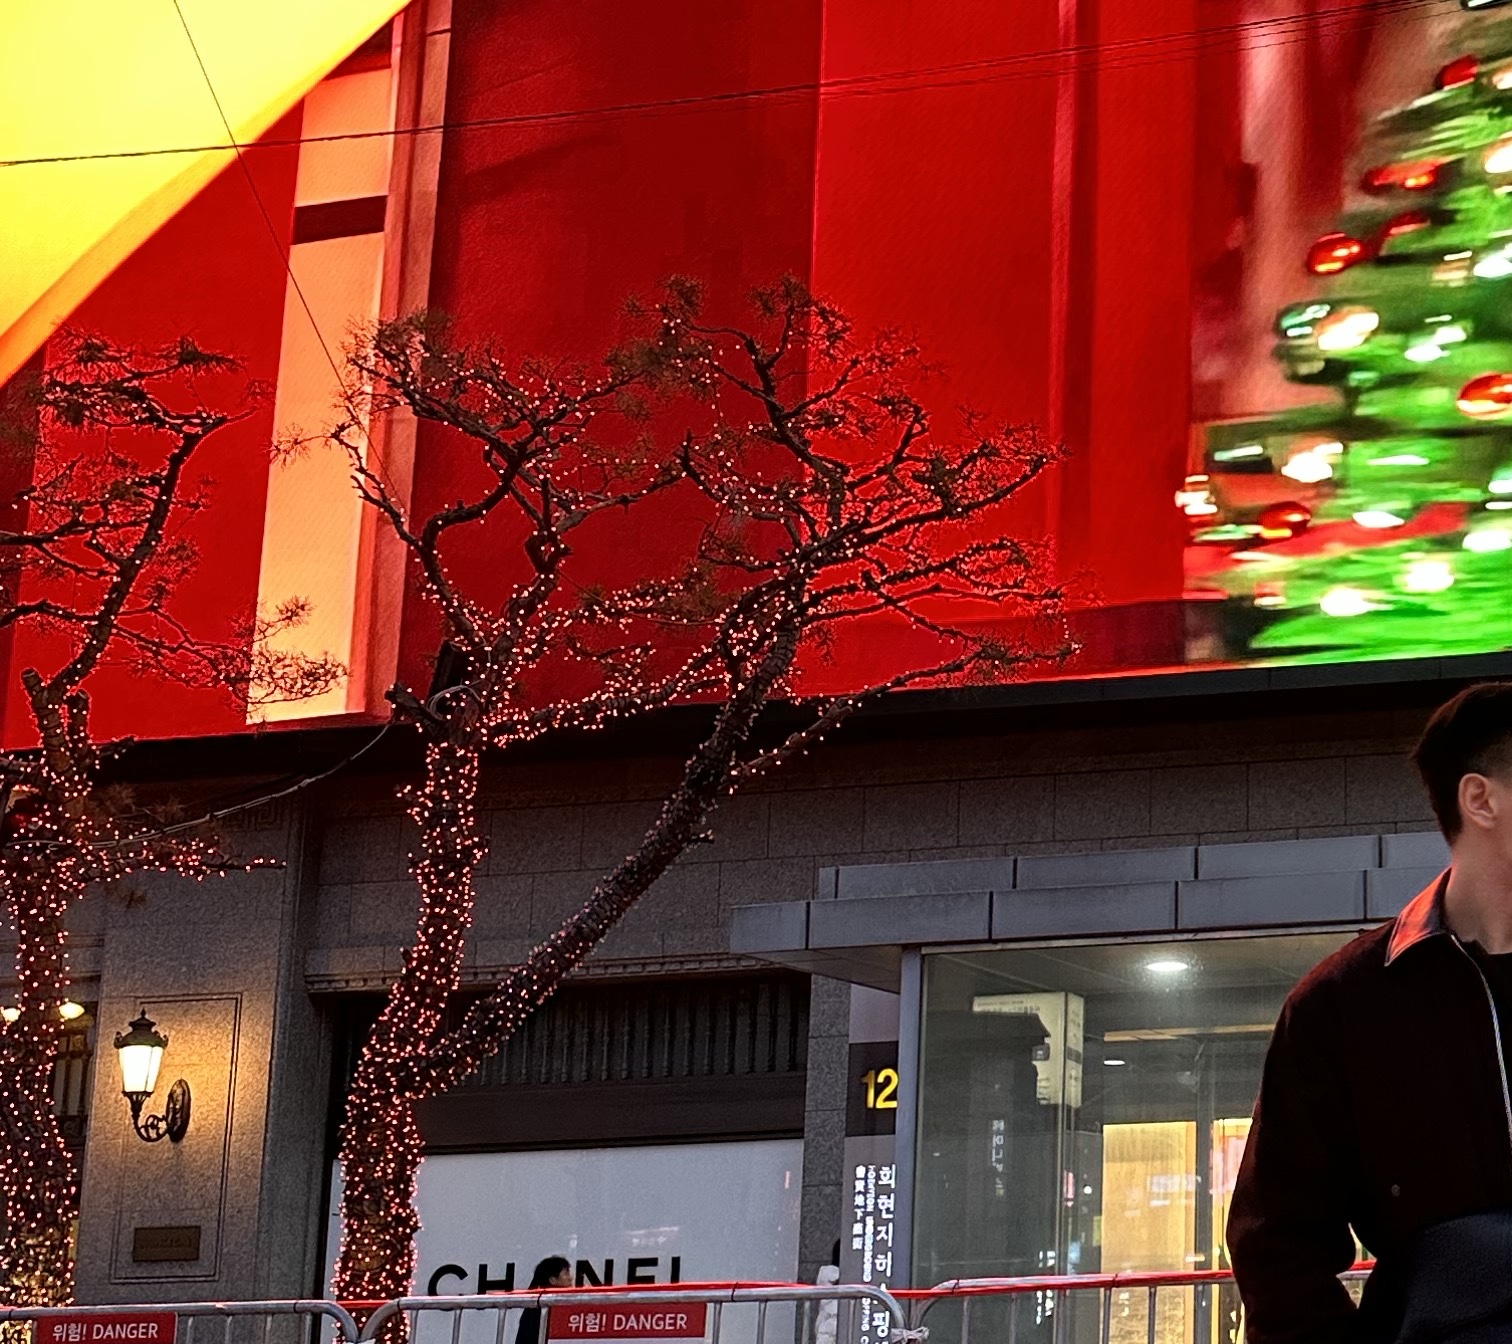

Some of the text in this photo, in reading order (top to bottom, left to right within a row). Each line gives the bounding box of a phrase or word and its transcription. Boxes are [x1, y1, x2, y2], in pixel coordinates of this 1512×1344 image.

[861, 1068, 899, 1109] 12
[52, 1322, 159, 1342] 위험! DANGER
[567, 1313, 688, 1333] 위험! DANGER
